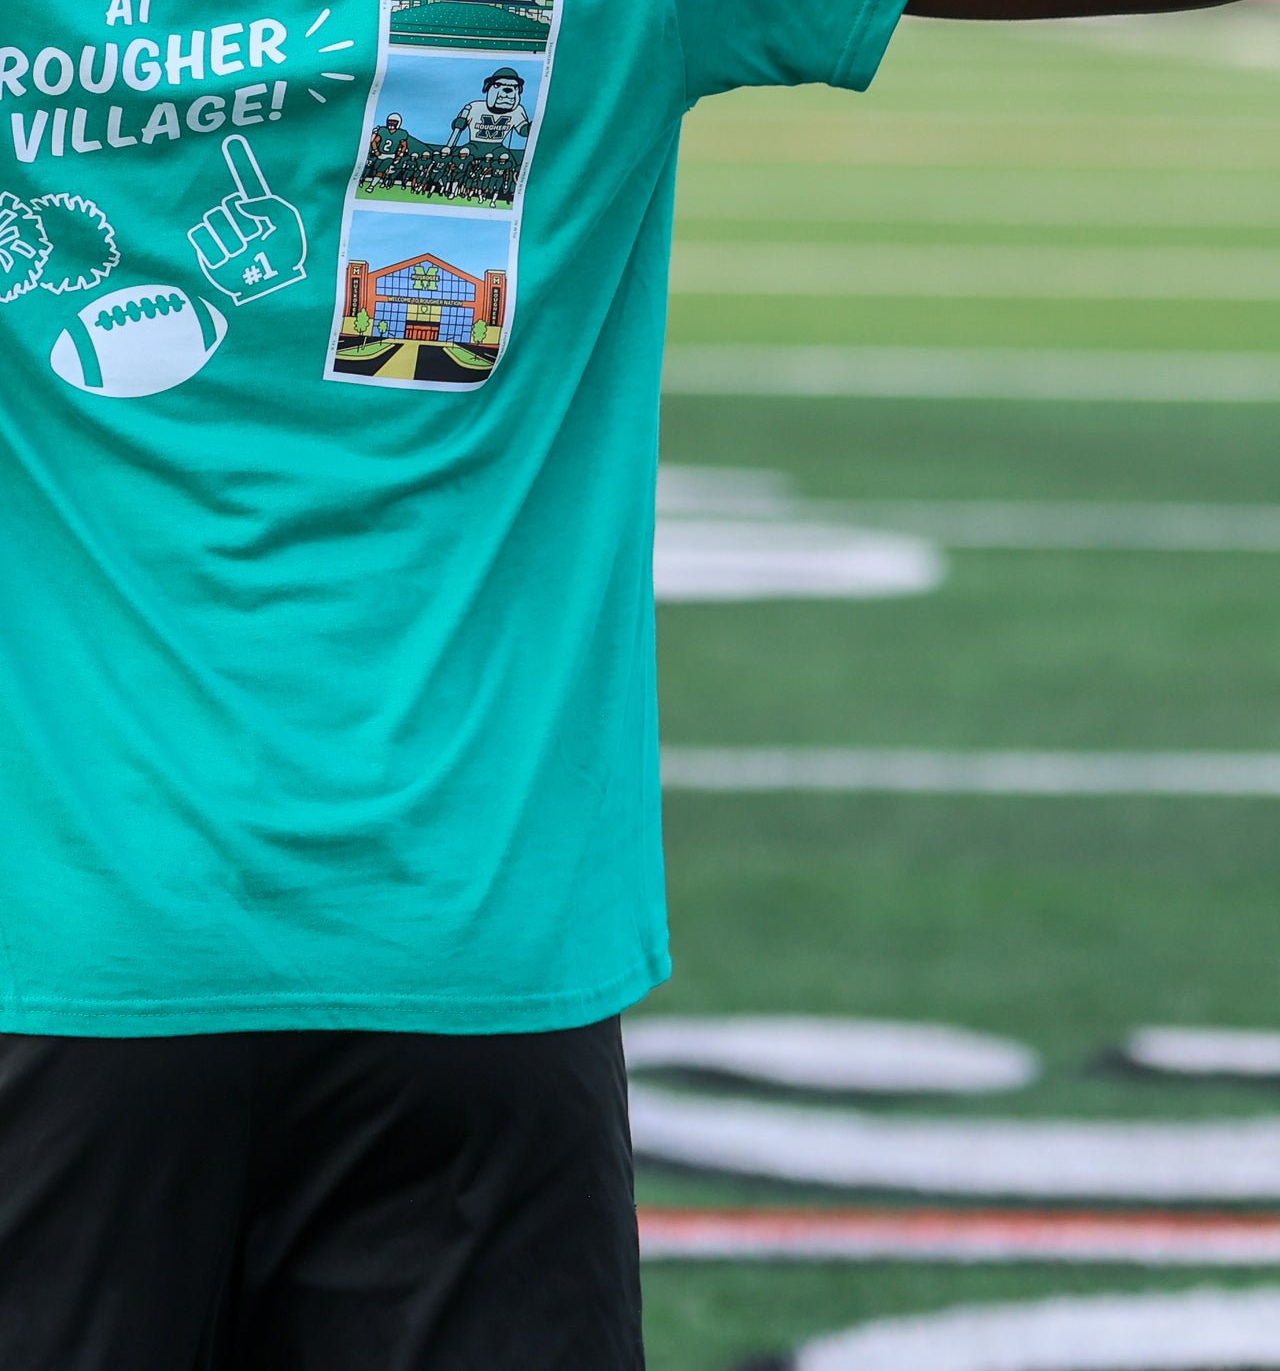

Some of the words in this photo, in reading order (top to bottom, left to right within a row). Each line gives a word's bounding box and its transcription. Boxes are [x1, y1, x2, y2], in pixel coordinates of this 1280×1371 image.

[11, 80, 288, 163] VILLAGE!
[383, 139, 392, 152] 2
[242, 252, 279, 286] #1
[352, 266, 360, 275] M
